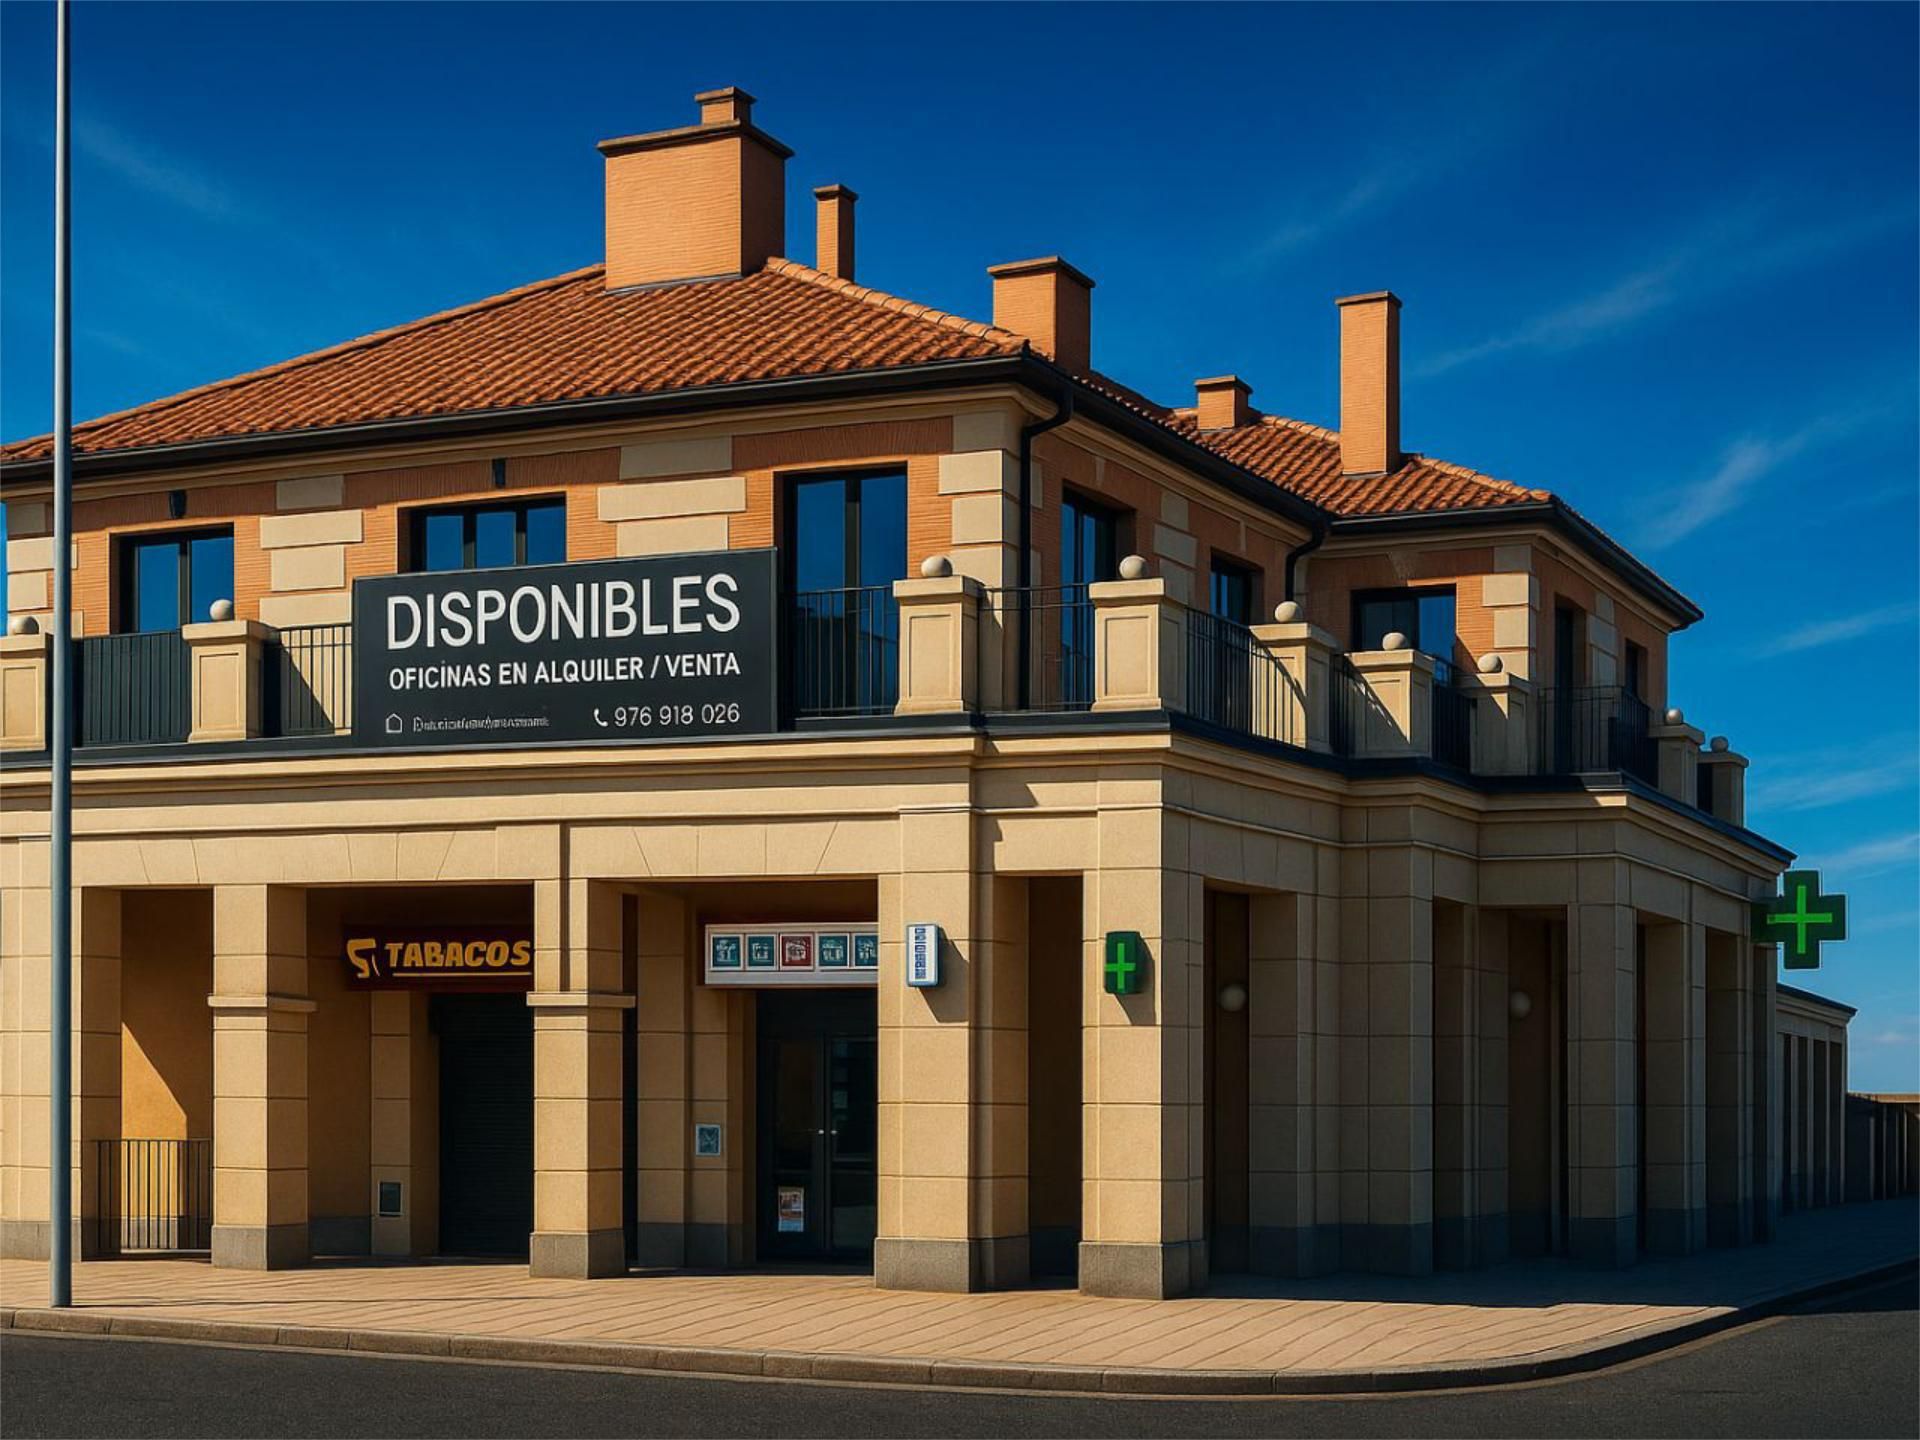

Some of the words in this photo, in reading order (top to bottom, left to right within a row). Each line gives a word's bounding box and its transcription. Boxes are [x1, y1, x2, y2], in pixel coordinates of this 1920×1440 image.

[387, 574, 741, 650] DISPONIBLES
[499, 662, 528, 685] EN
[534, 656, 644, 684] ALQUILER
[650, 656, 660, 679] /
[664, 652, 741, 677] VENTA
[613, 706, 652, 727] 976
[658, 705, 694, 726] 918
[702, 702, 741, 724] 026
[385, 940, 531, 967] TABACOS
